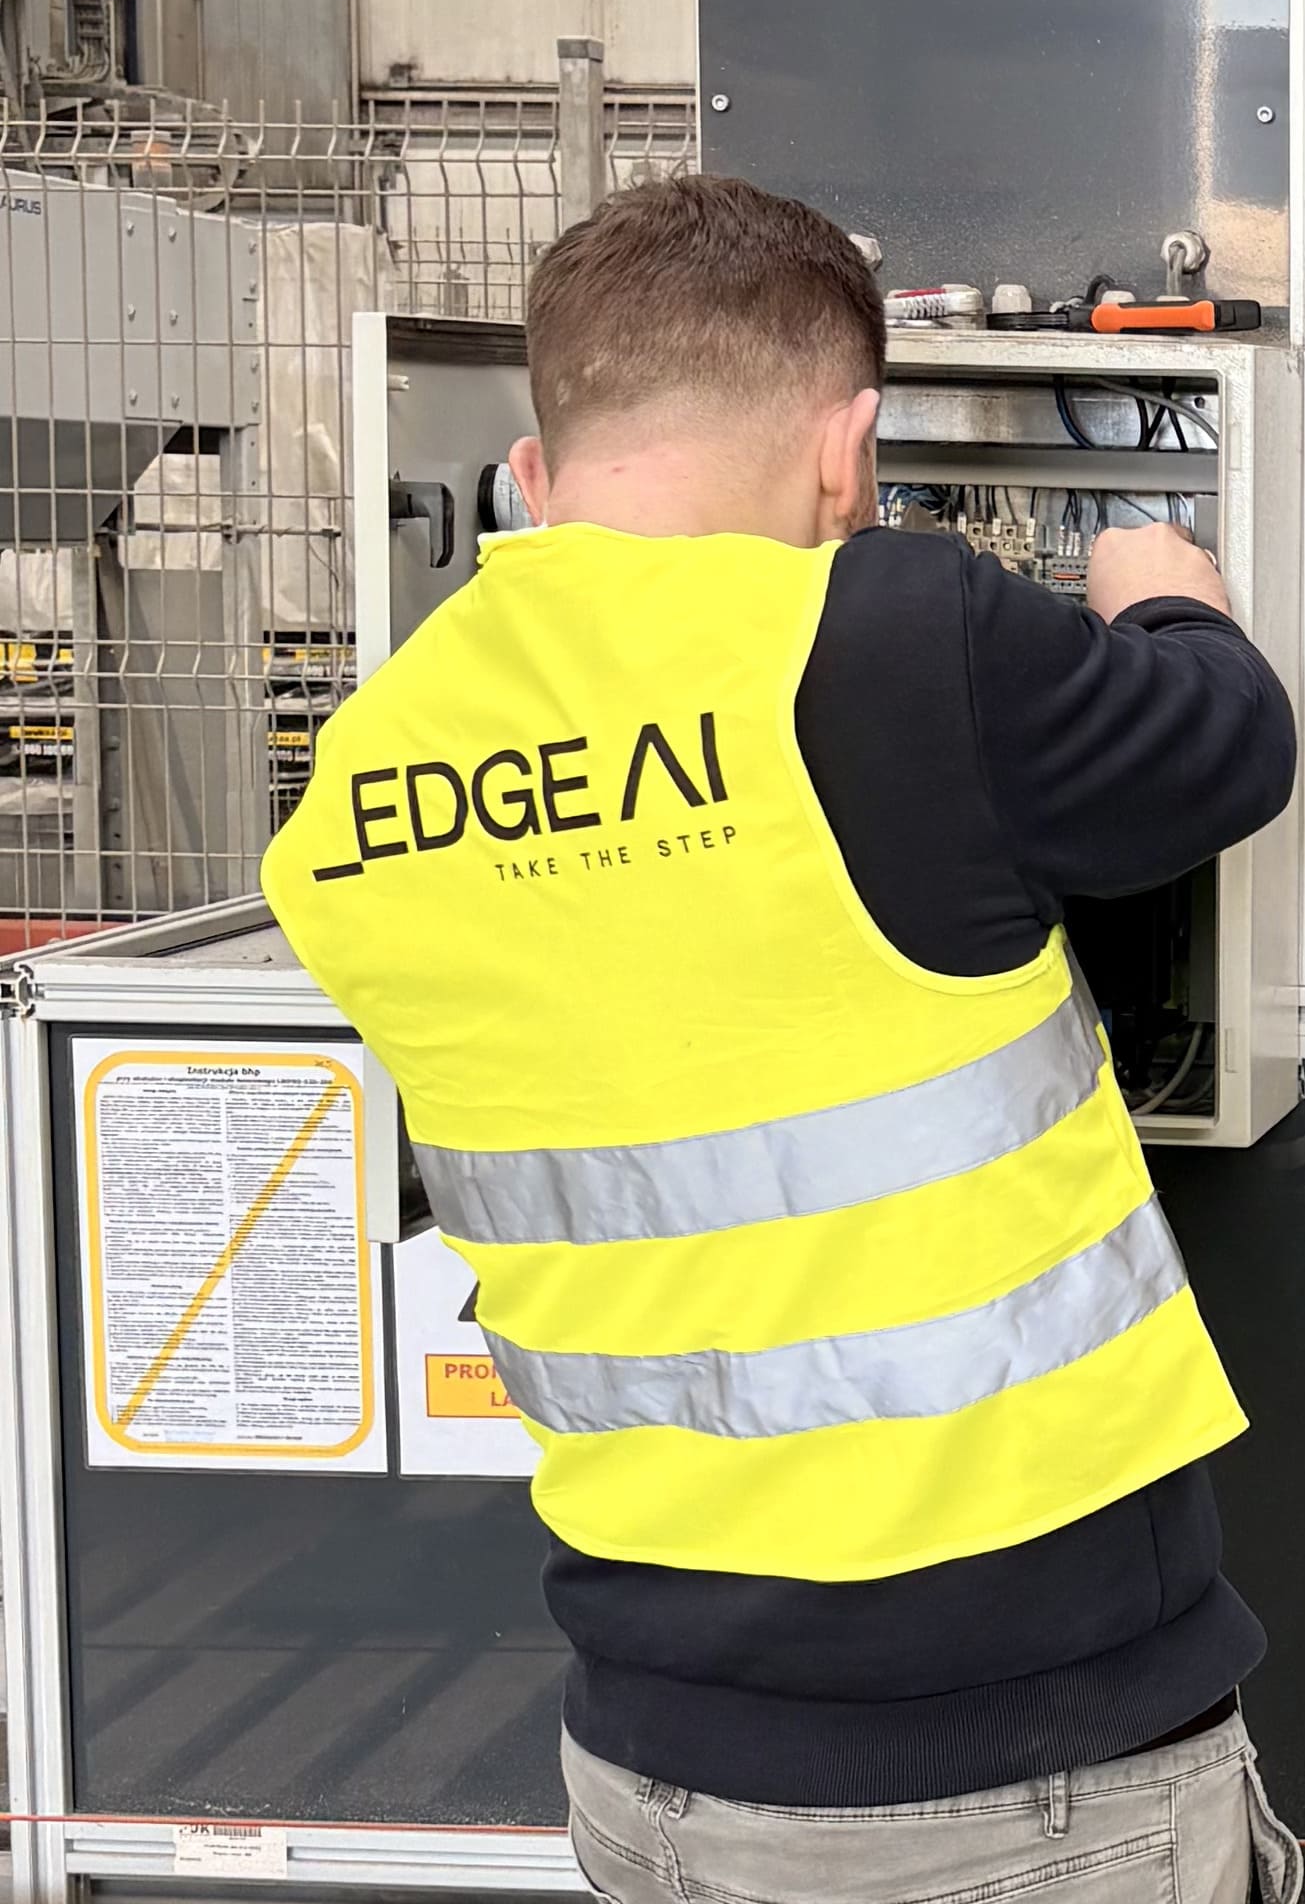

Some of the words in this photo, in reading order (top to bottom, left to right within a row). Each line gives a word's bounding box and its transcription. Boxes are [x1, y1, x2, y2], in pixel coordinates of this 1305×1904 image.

[495, 856, 560, 882] TAKE
[580, 845, 632, 873] THE
[656, 824, 739, 859] STEP
[186, 1065, 239, 1078] Instrukcja
[241, 1066, 261, 1077] bhp
